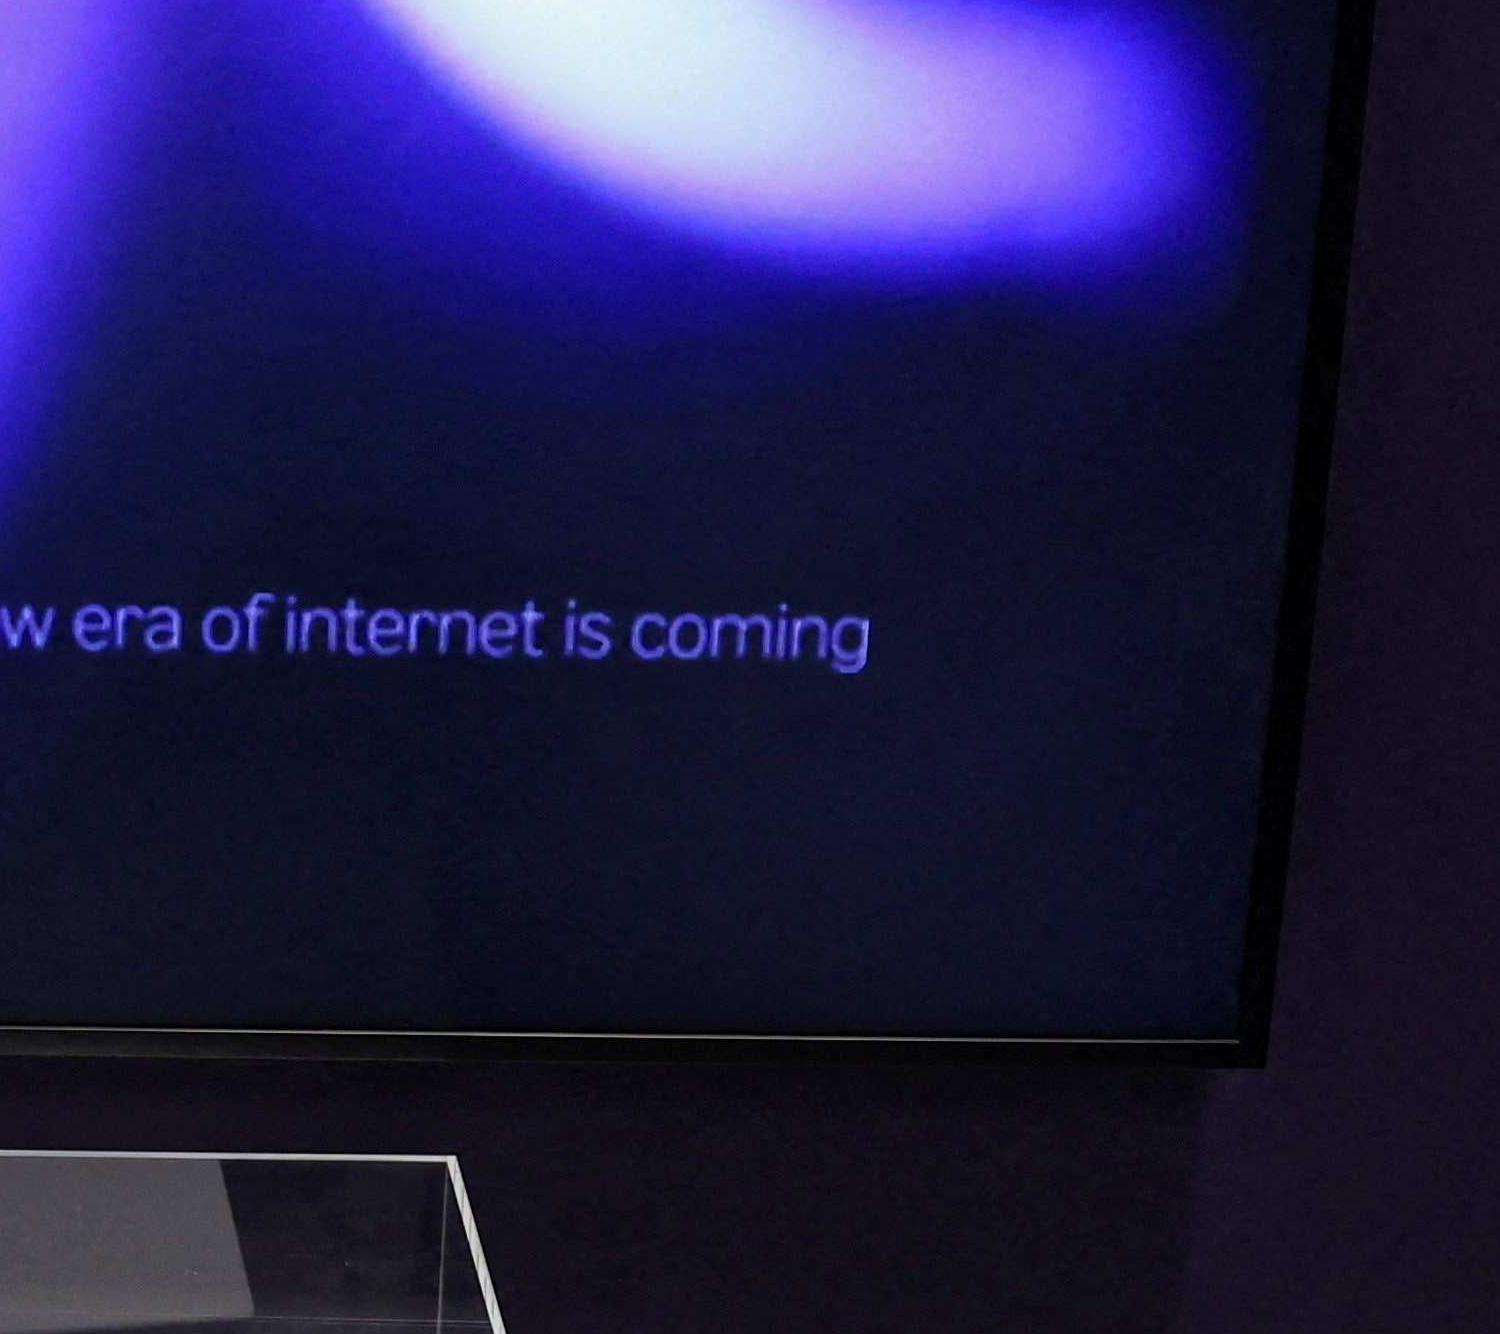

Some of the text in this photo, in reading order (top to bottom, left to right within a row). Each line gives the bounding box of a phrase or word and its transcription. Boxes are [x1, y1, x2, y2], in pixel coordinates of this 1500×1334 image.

[72, 602, 180, 652] era
[201, 591, 274, 654] of
[284, 596, 544, 657] internet
[563, 599, 611, 658] is
[630, 603, 870, 673] coming
